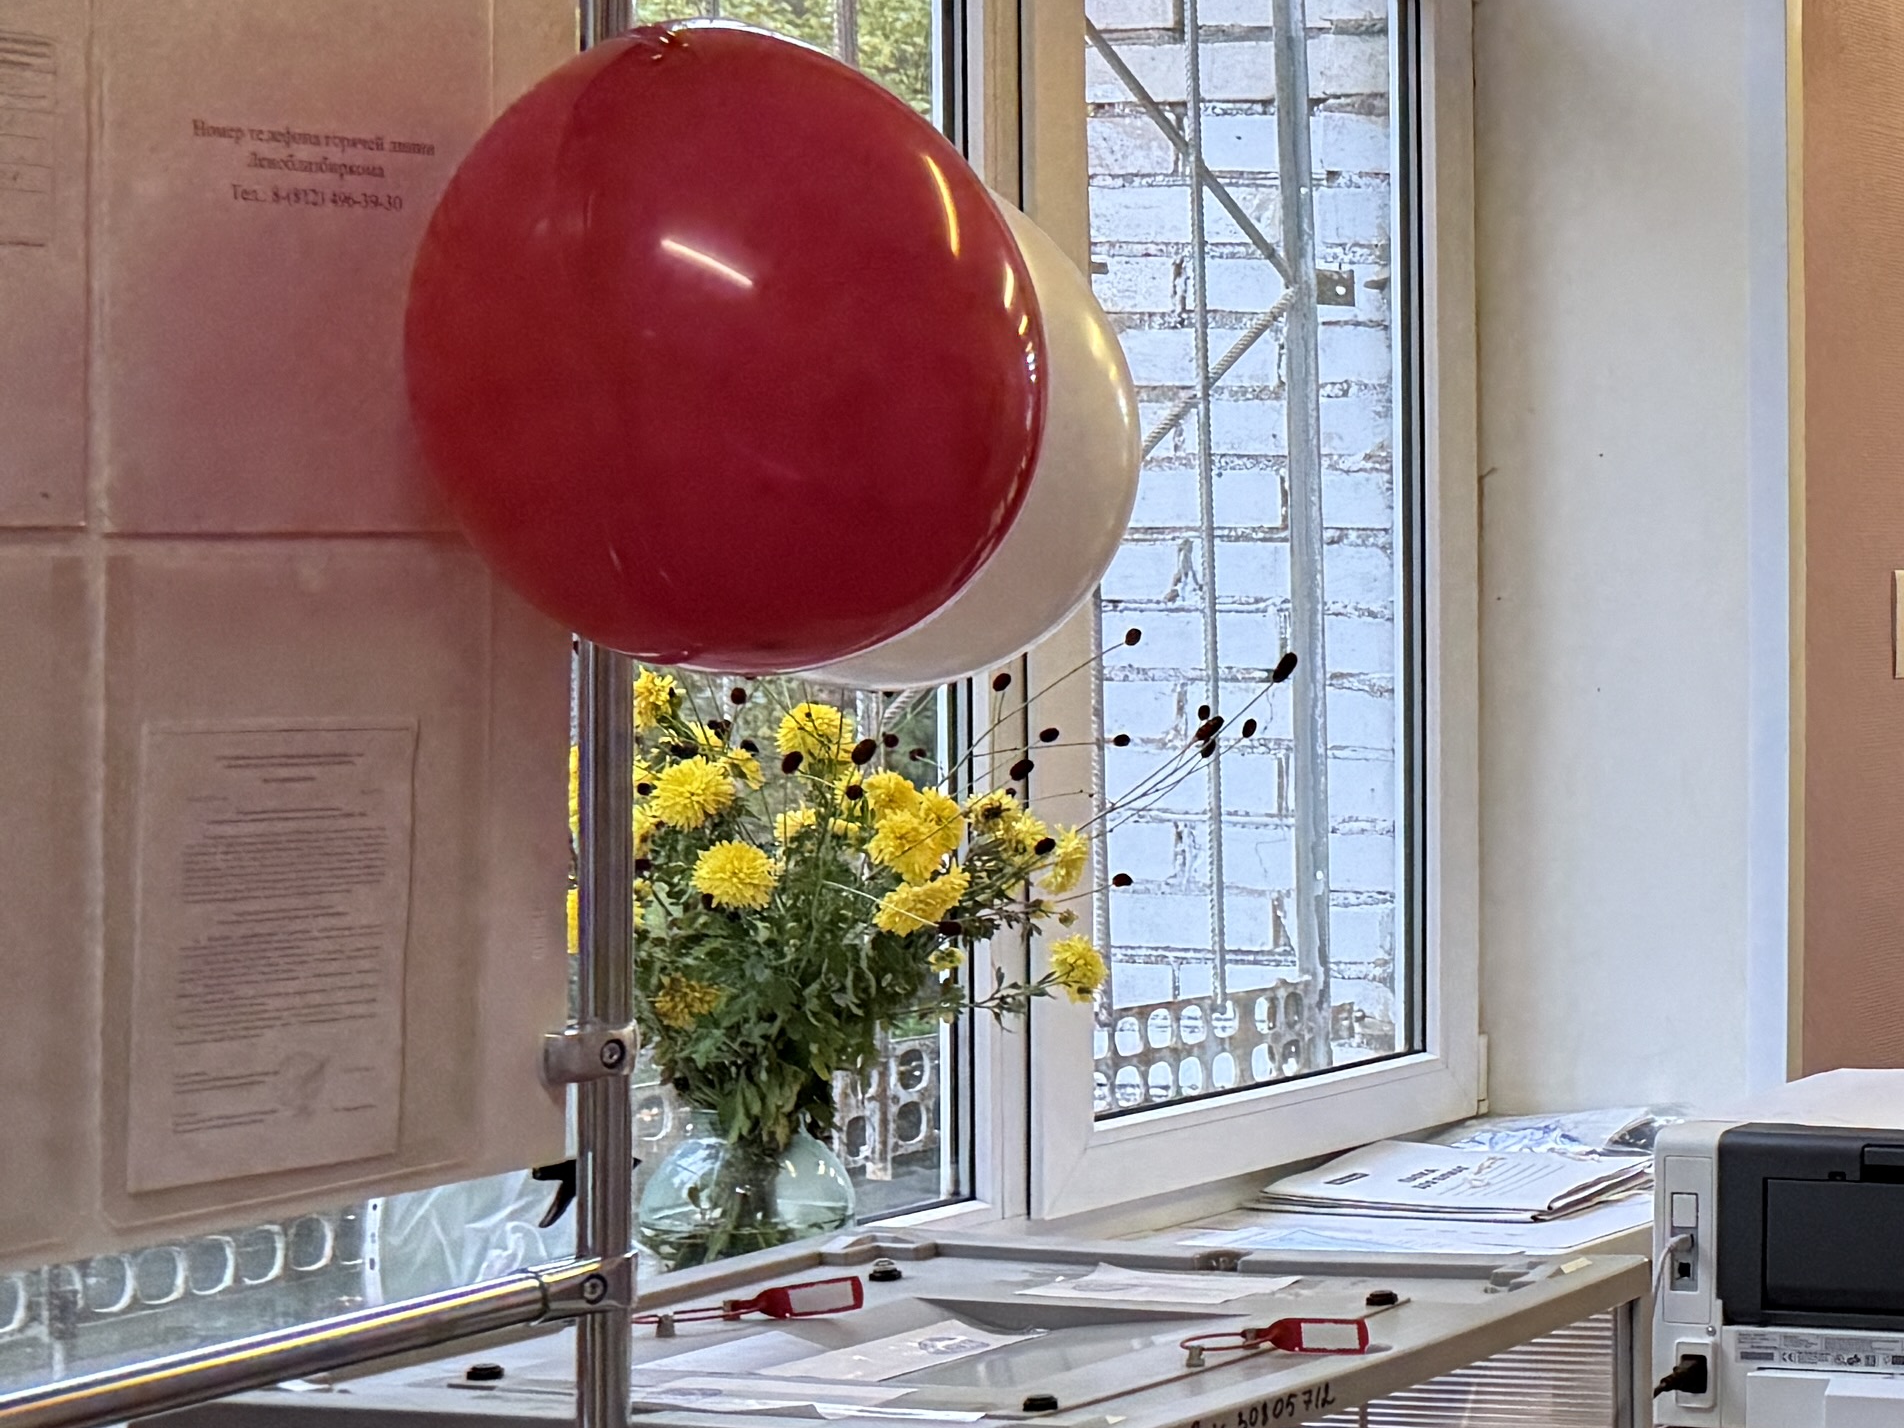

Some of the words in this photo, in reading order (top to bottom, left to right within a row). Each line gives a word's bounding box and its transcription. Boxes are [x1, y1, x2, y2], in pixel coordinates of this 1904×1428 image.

[192, 119, 245, 144] Номер
[249, 126, 320, 148] телефона
[325, 135, 384, 153] горячей
